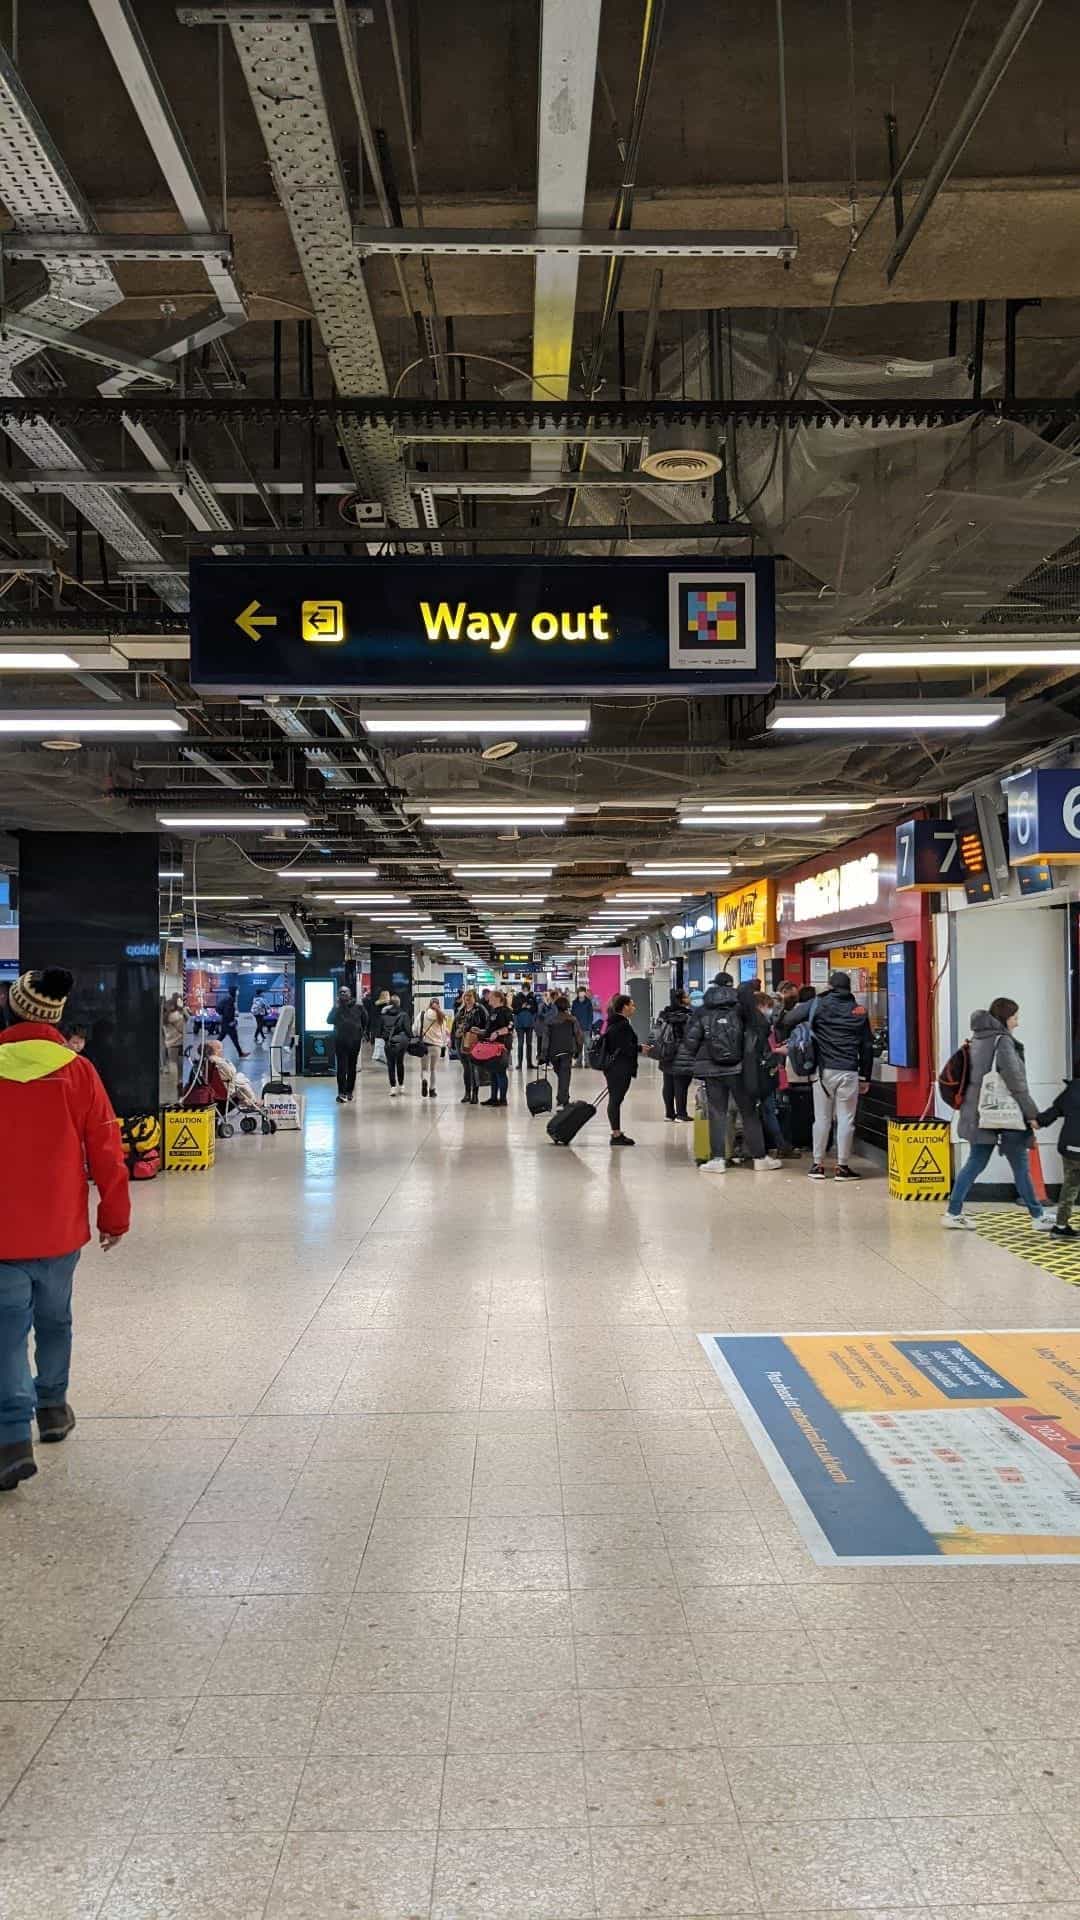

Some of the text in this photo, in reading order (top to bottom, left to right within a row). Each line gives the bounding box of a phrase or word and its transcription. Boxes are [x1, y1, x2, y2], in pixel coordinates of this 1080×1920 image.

[420, 602, 609, 650] Way out
[900, 835, 910, 877] 7
[933, 832, 958, 873] 7
[907, 1136, 944, 1144] CAUTION
[1031, 1424, 1067, 1441] 2022
